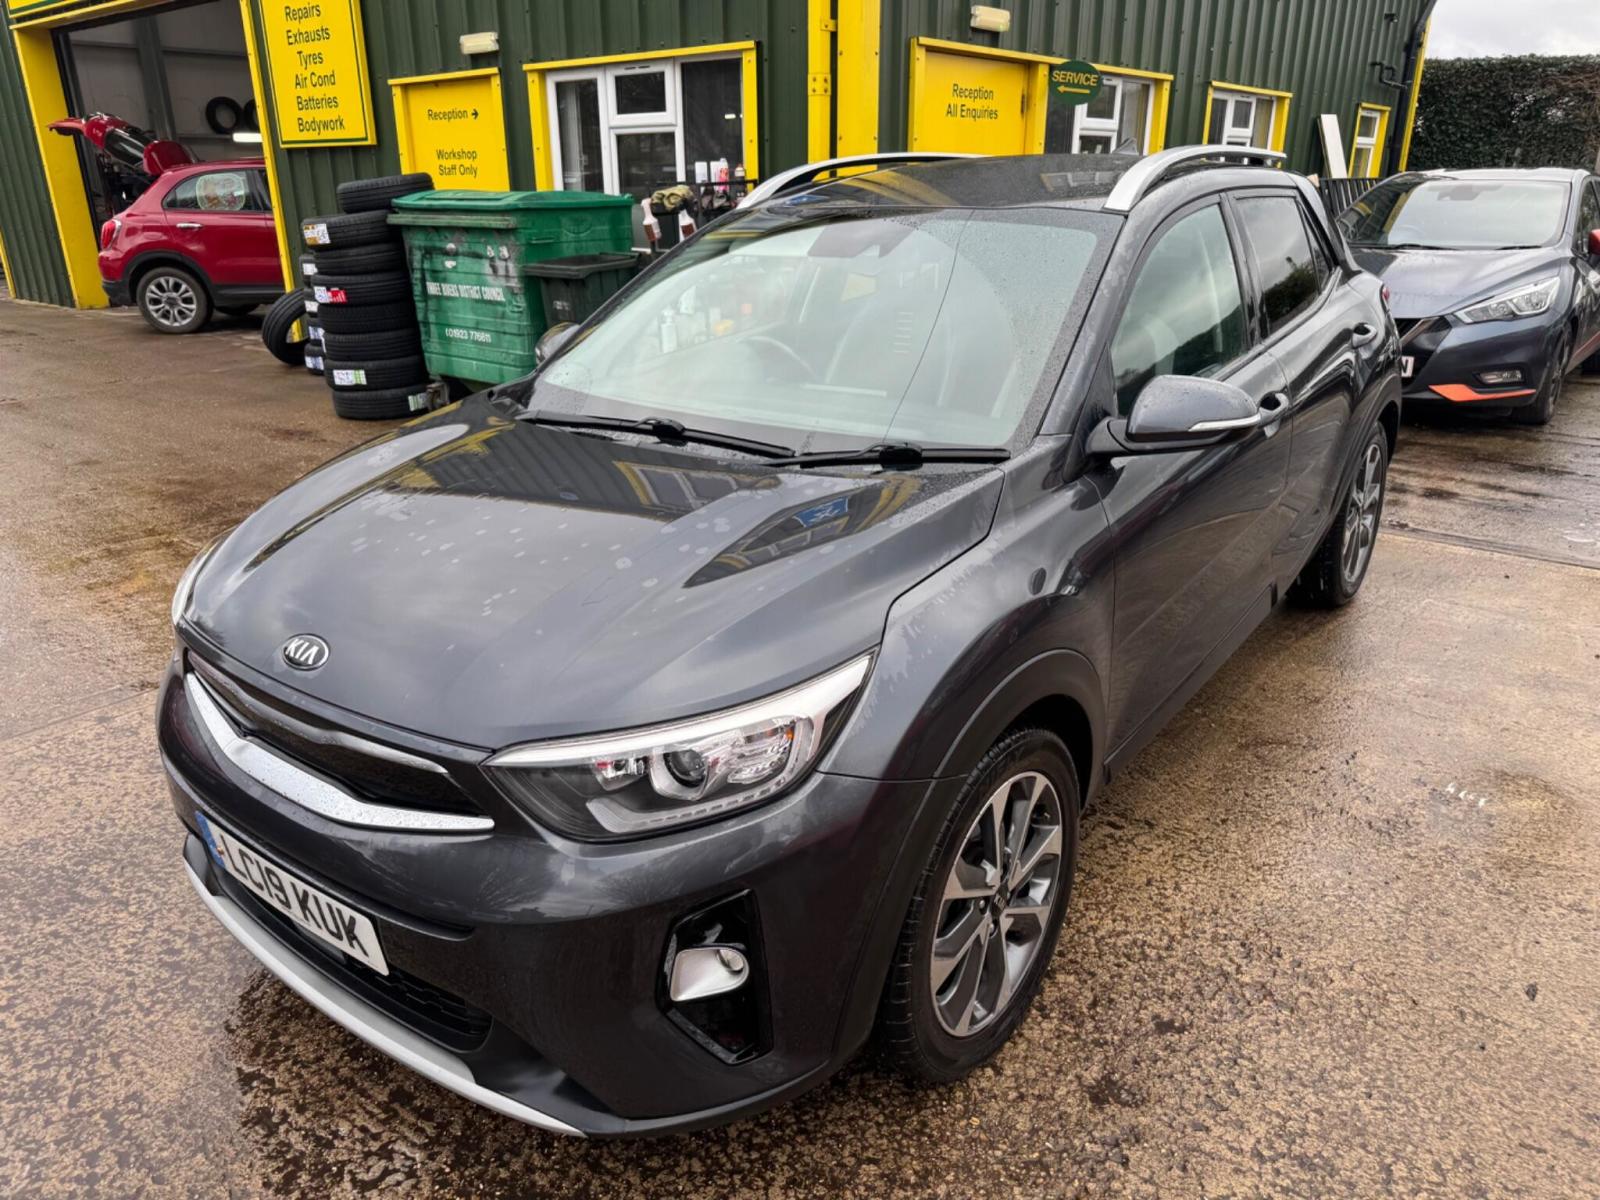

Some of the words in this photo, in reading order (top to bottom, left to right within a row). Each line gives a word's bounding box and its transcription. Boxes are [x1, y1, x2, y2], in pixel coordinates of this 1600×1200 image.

[284, 3, 321, 24] Repairs
[286, 26, 331, 46] Exhausts
[297, 50, 324, 70] Tyres
[295, 73, 307, 89] Air
[310, 70, 336, 88] Cond
[1052, 70, 1099, 87] SERVICE
[296, 93, 339, 111] Batteries
[952, 83, 994, 102] Reception
[427, 108, 468, 123] Reception
[946, 103, 958, 118] All
[960, 104, 998, 121] Enquiries
[297, 115, 345, 136] Bodywork
[436, 148, 477, 161] Workshop
[438, 164, 457, 176] Staff
[458, 164, 478, 179] Only
[285, 638, 319, 665] KIA
[220, 834, 292, 910] LC19
[290, 881, 369, 957] KUK
